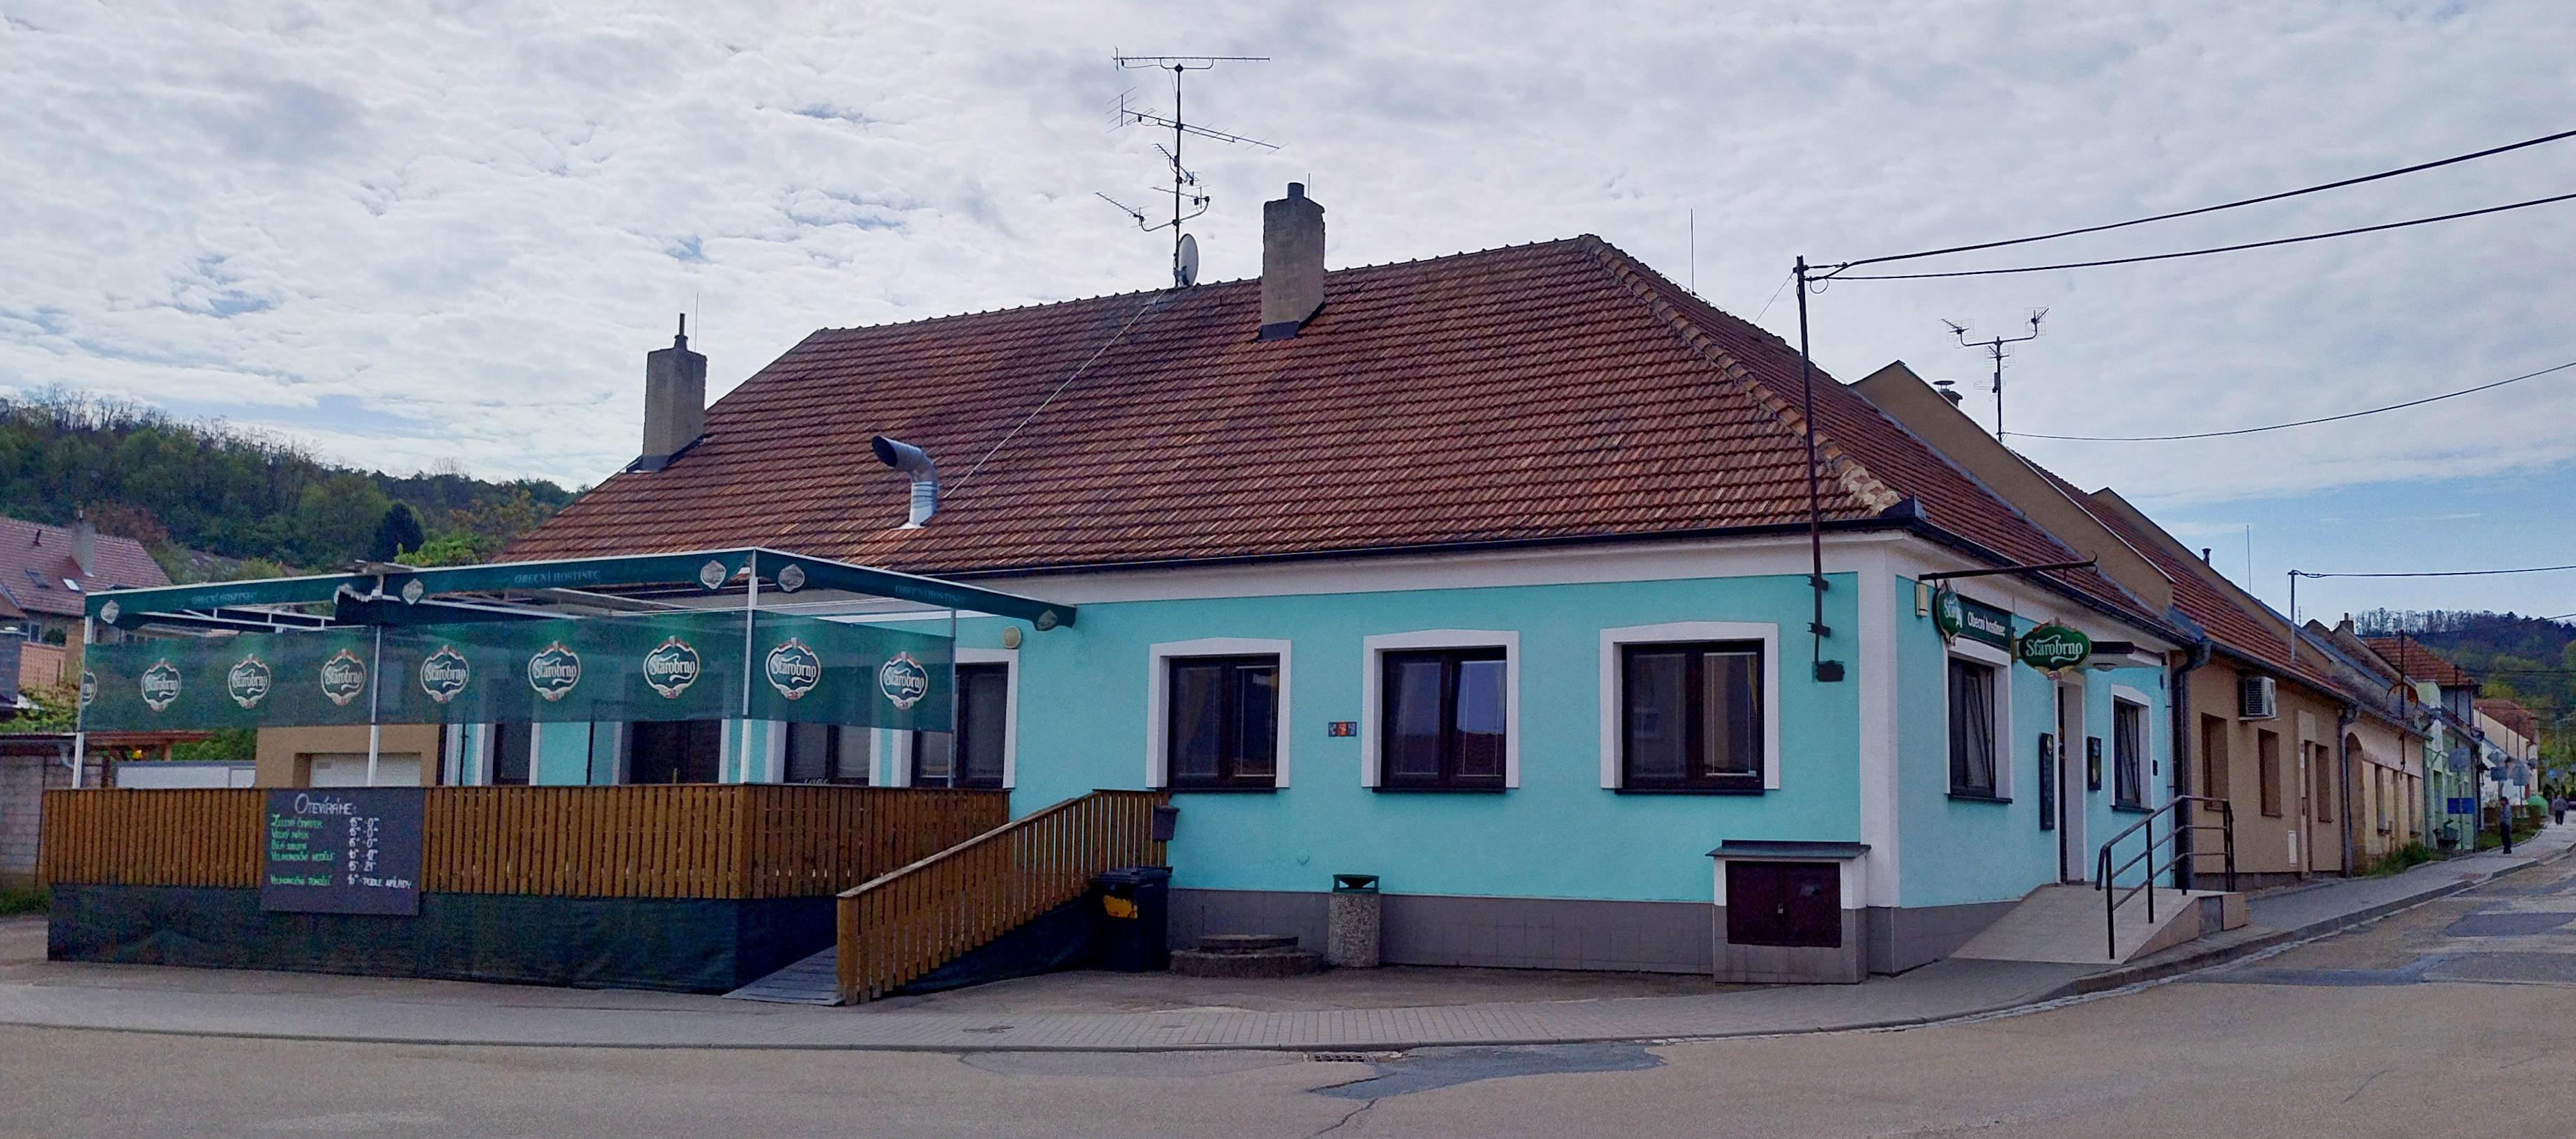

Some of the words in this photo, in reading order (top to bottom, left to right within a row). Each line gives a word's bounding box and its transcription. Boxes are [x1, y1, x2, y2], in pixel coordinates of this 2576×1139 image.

[2026, 634, 2083, 664] Starobrno
[325, 664, 363, 691] Starobrno
[424, 661, 466, 687] Starobrno
[532, 657, 577, 685] Starobrno
[647, 653, 696, 682] Starobrno
[770, 655, 816, 683] Starobrno
[884, 668, 924, 694] Starobrno
